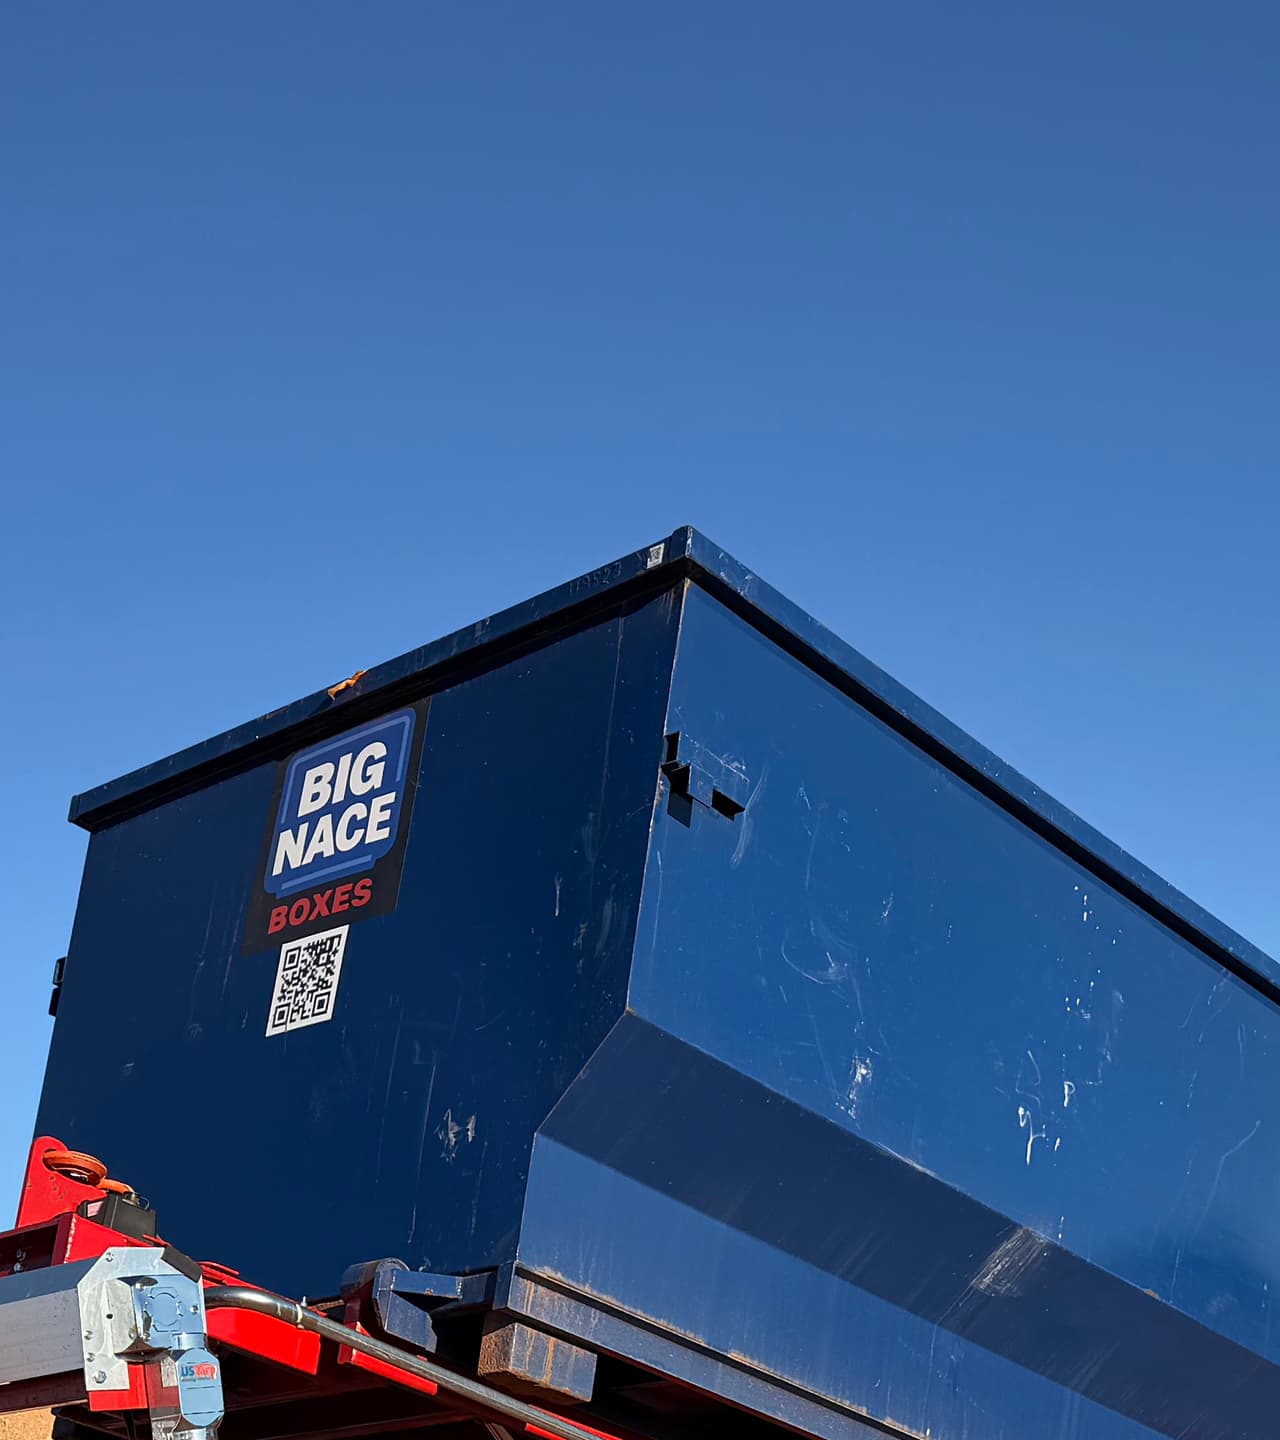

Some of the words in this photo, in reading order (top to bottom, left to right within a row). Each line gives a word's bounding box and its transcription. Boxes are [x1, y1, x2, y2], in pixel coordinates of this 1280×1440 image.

[297, 741, 388, 818] BIG
[271, 791, 397, 877] NACE
[267, 878, 374, 935] BOXES
